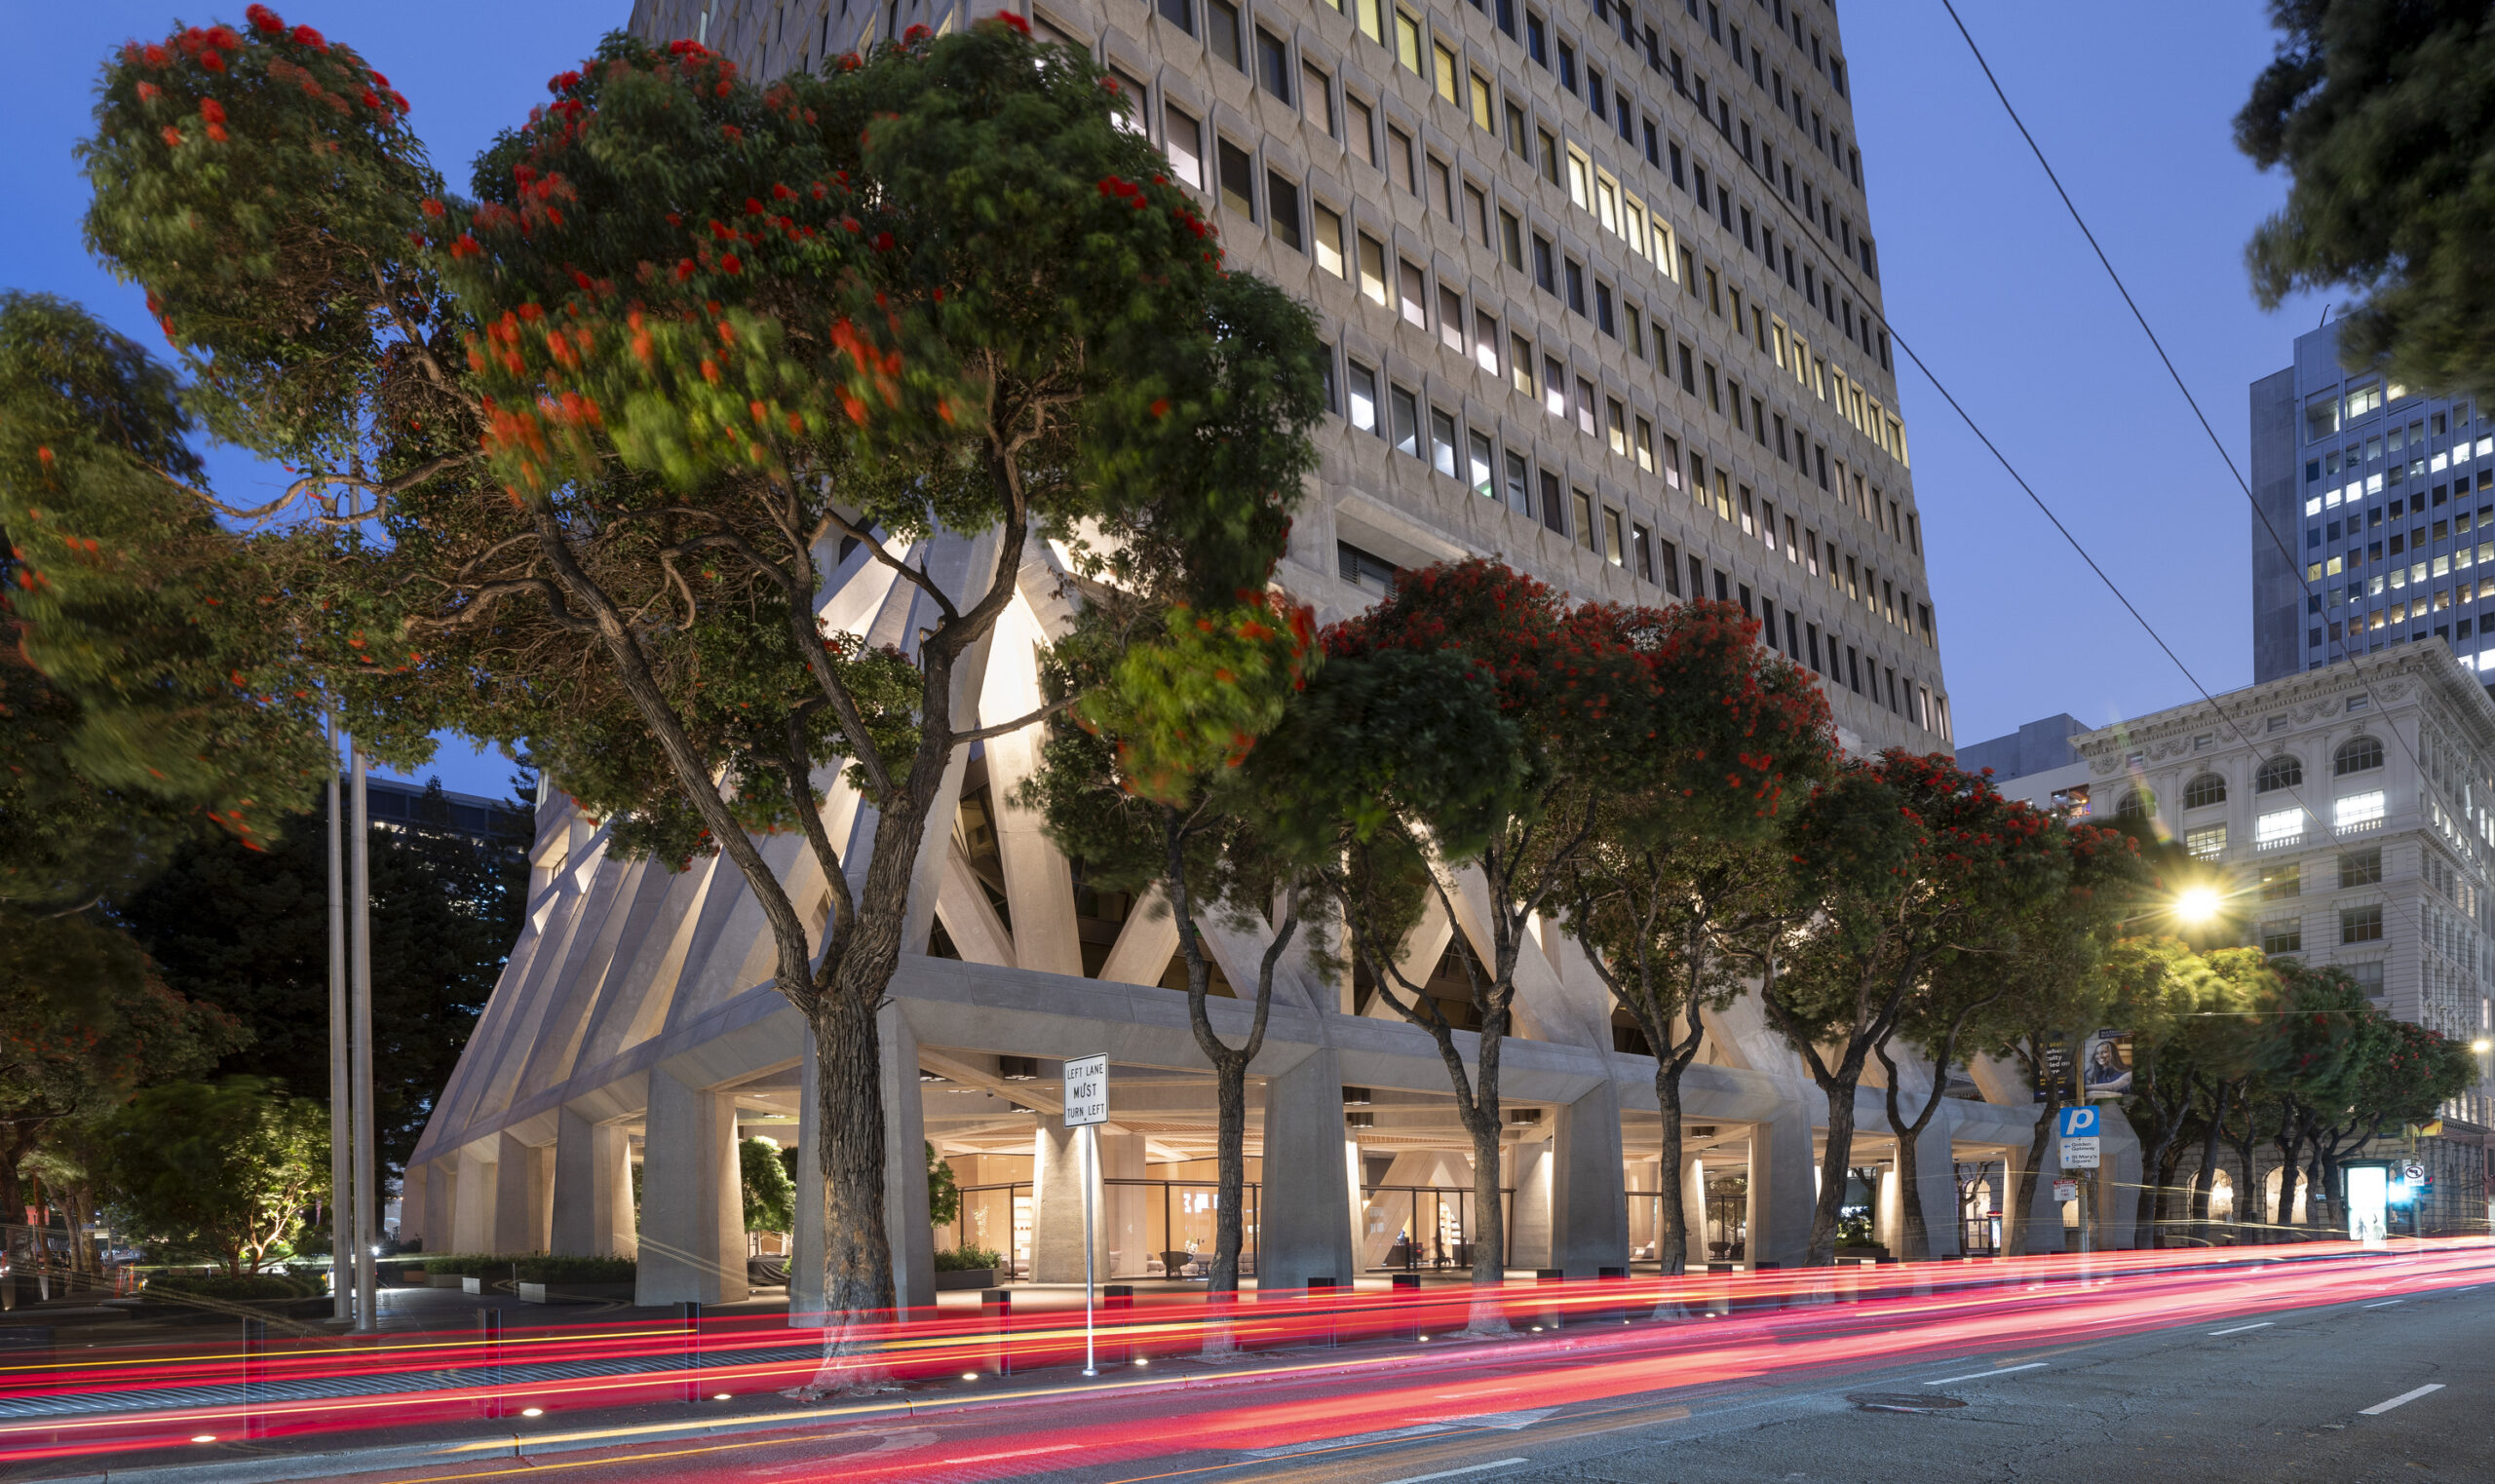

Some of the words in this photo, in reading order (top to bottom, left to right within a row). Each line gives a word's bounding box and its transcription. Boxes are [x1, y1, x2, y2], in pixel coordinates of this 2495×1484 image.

[1067, 1067, 1083, 1080] LEFT
[1086, 1063, 1103, 1077] LANE
[1073, 1083, 1097, 1099] MUST
[1067, 1106, 1084, 1119] TURN
[1088, 1103, 1105, 1116] LEFT
